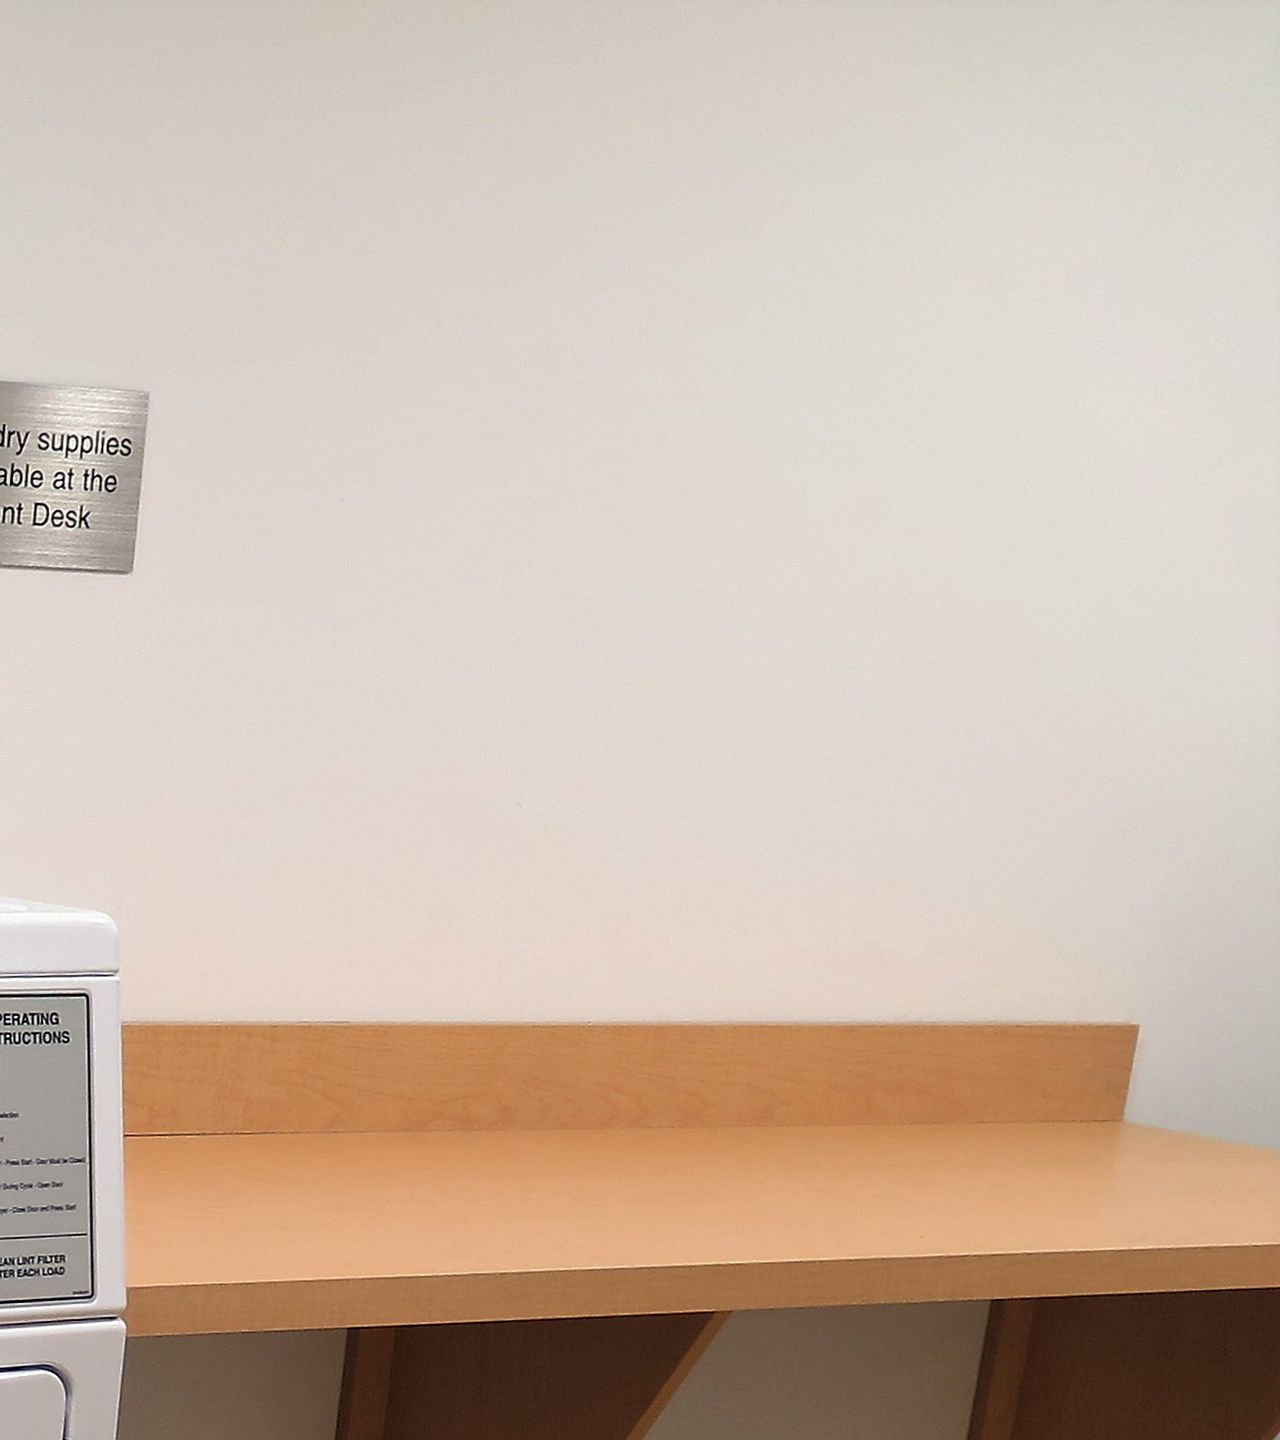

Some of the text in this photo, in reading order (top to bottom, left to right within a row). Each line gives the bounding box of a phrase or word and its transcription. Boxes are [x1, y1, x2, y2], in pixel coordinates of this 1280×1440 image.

[38, 433, 133, 460] supplies
[53, 468, 74, 489] at
[83, 469, 118, 493] the
[32, 503, 91, 529] Desk
[17, 1256, 35, 1265] LINT
[38, 1255, 65, 1264] FILTER
[17, 1269, 40, 1277] EACH
[42, 1267, 65, 1276] LOAD
